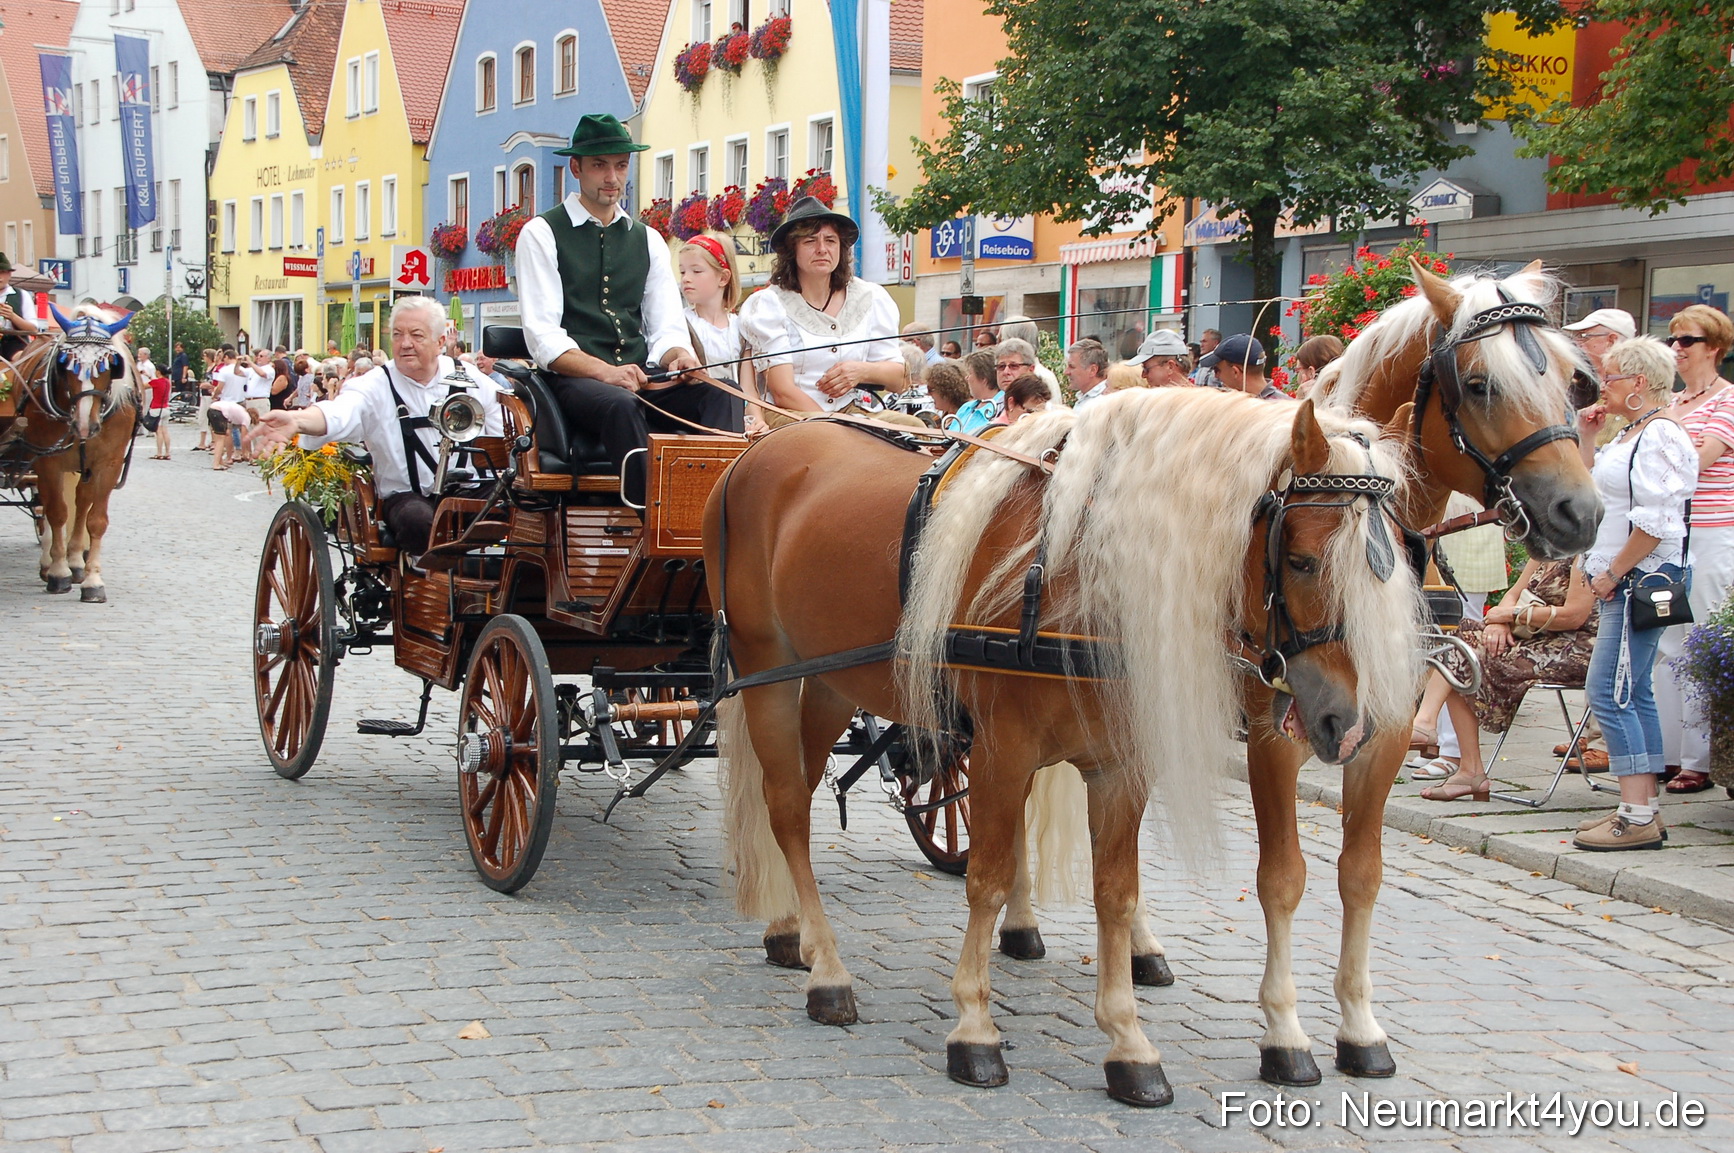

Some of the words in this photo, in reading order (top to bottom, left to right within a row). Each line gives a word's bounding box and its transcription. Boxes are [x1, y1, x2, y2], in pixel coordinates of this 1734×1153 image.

[133, 110, 147, 177] RUPPERT
[257, 165, 281, 188] HOTEL
[288, 162, 316, 182] Lehmeier
[137, 181, 150, 207] K&L
[965, 221, 972, 255] P
[982, 244, 1030, 256] Reisebüro
[353, 254, 359, 279] P
[254, 274, 289, 291] Restaurant
